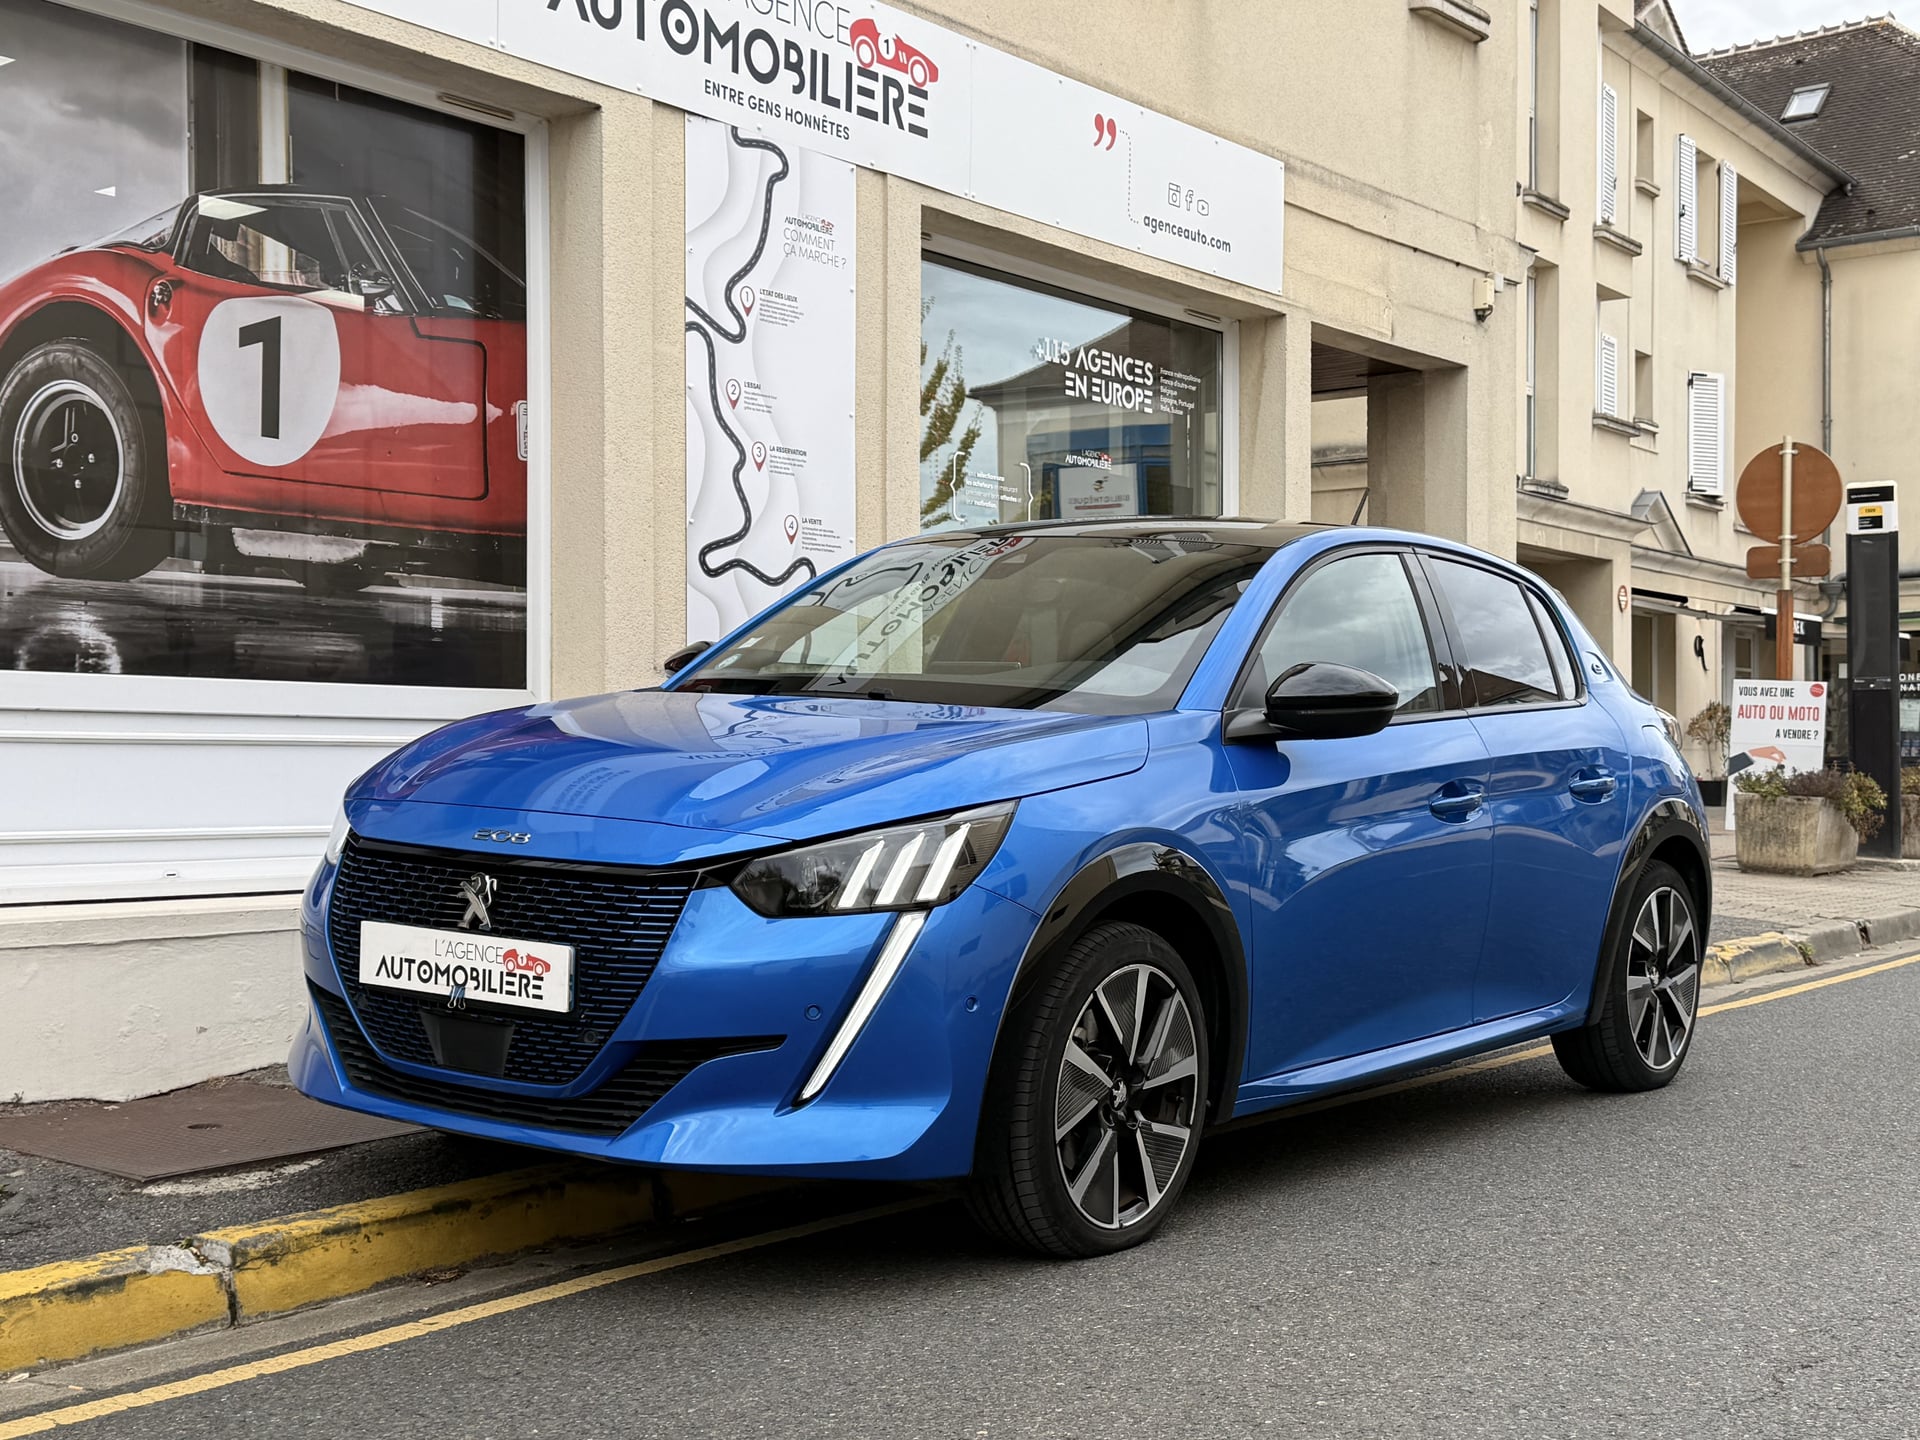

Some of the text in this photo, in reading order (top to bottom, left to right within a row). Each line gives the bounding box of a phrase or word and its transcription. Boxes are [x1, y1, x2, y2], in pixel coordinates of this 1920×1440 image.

[704, 79, 850, 141] ENTRE GENS HONNÊTES
[783, 227, 836, 251] COMMENT
[1143, 214, 1232, 253] agenceauto.com
[783, 242, 797, 258] ÇA
[799, 246, 839, 268] MARCHE
[239, 315, 281, 439] 1
[1075, 346, 1154, 386] AGENCES
[731, 385, 737, 394] 2
[1065, 371, 1153, 414] EN EUROPE
[756, 446, 762, 458] 3
[788, 521, 794, 530] 4
[1738, 686, 1795, 698] VOUS AVEZ UNE
[1737, 704, 1820, 722] AUTO OU MOTO
[1775, 728, 1819, 740] A VENDRE ?
[472, 829, 532, 845] 208
[434, 938, 504, 965] L'AGENCE
